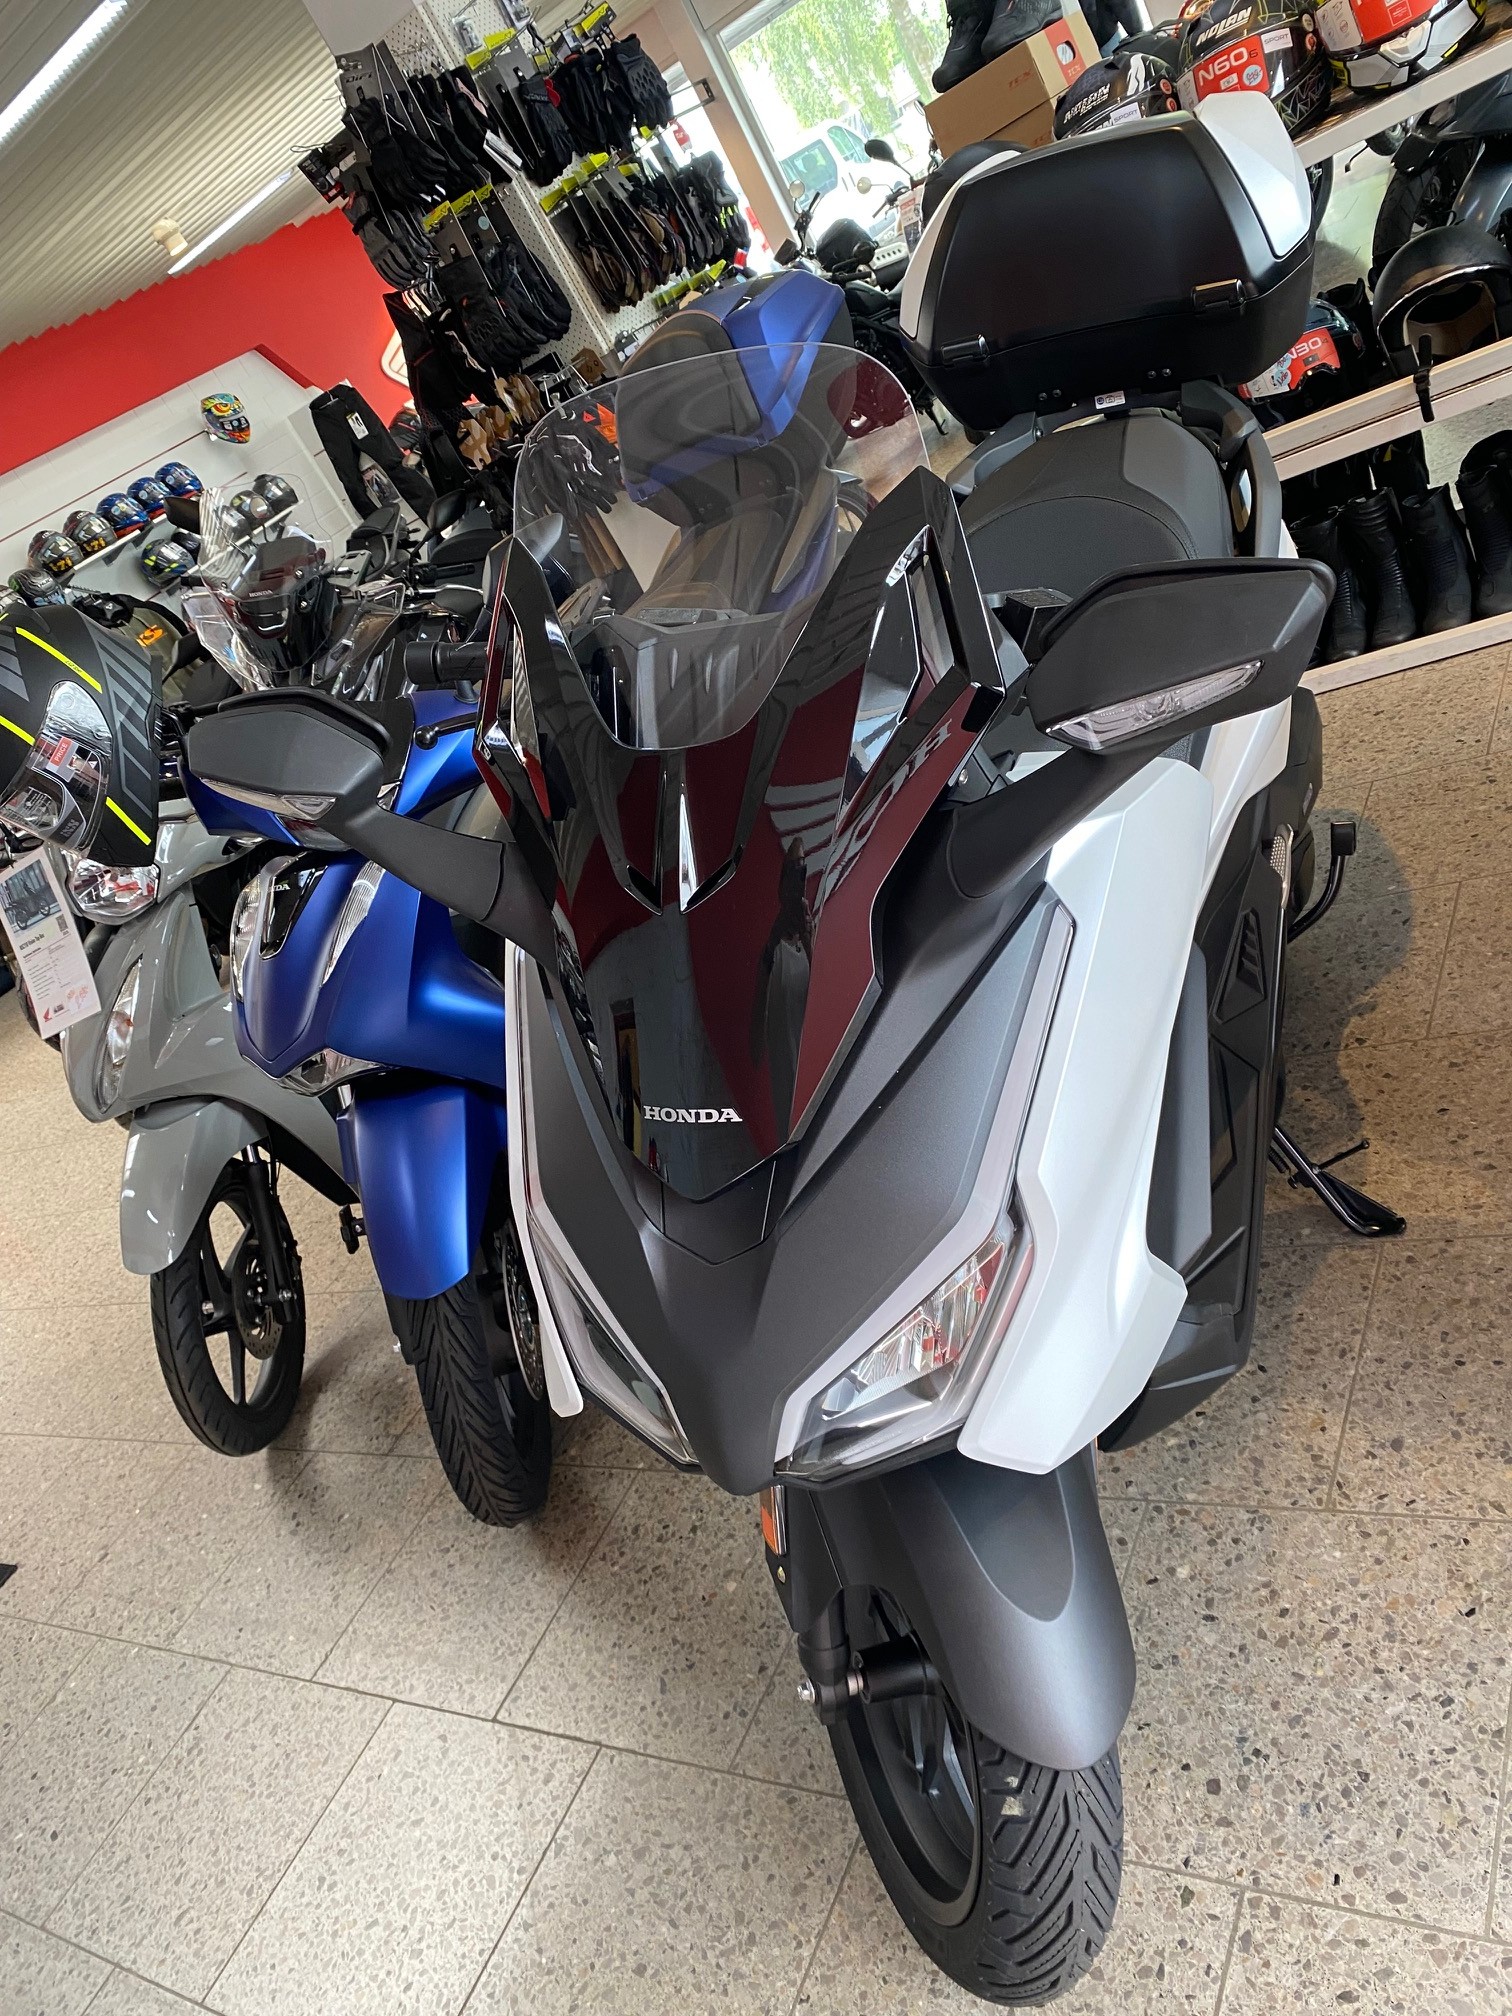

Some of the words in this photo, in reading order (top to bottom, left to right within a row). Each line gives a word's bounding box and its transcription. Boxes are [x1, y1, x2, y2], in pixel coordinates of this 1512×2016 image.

[1196, 6, 1252, 46] NOLAN
[1264, 33, 1289, 44] SPORT
[1199, 47, 1249, 86] N60
[1114, 109, 1138, 123] SPORT
[248, 589, 274, 598] HONDA
[54, 742, 68, 763] PRICE
[643, 1105, 743, 1123] HONDA
